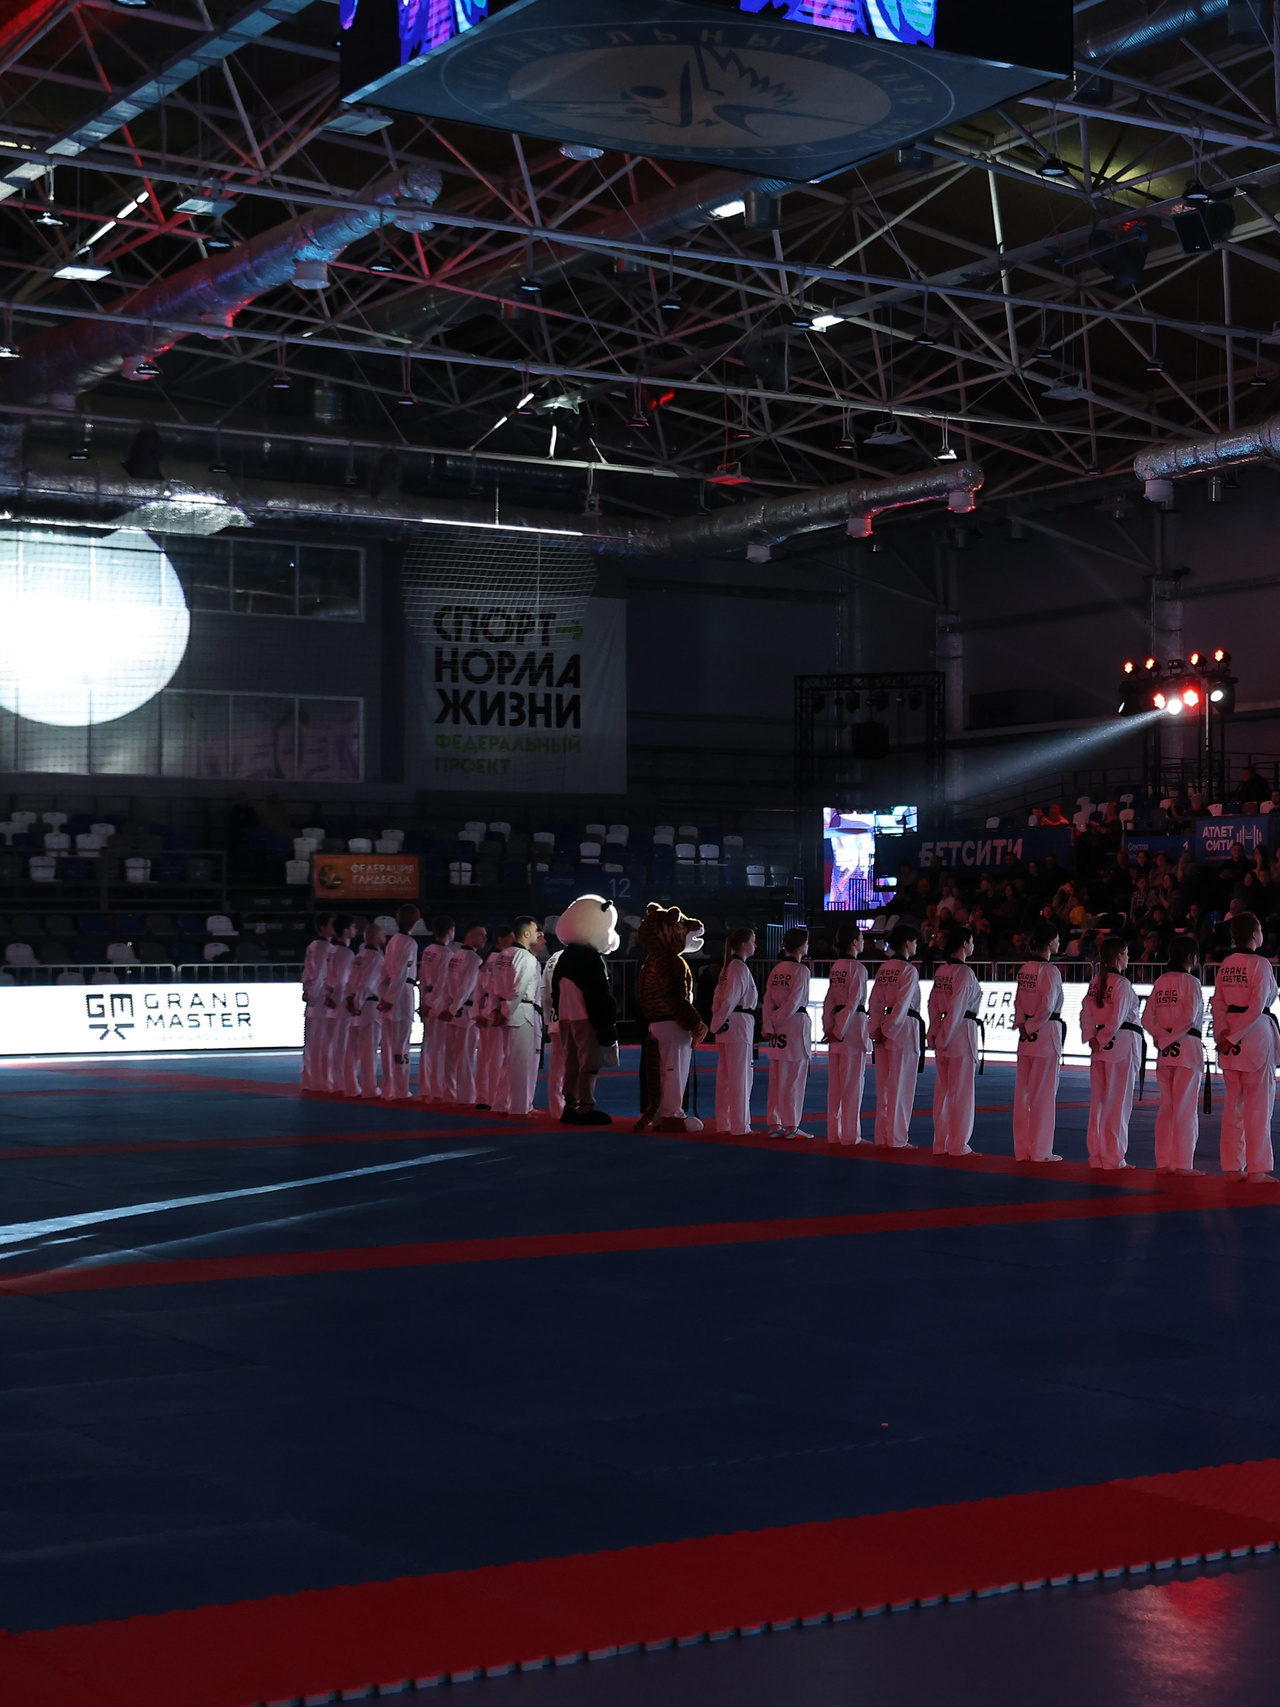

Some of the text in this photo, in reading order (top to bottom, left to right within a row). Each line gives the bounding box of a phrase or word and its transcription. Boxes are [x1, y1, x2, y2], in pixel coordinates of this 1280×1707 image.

[434, 605, 556, 646] СПОРТ
[434, 647, 581, 689] НОРМА
[434, 689, 581, 729] ЖИЗНИ
[435, 732, 581, 754] ФЕДЕРАЛЬНЫЙ
[435, 756, 510, 775] ПРОЕКТ
[352, 875, 411, 885] ГАНДБОЛА
[608, 877, 632, 898] 12
[145, 992, 249, 1009] GRAND
[146, 1012, 252, 1029] MASTER
